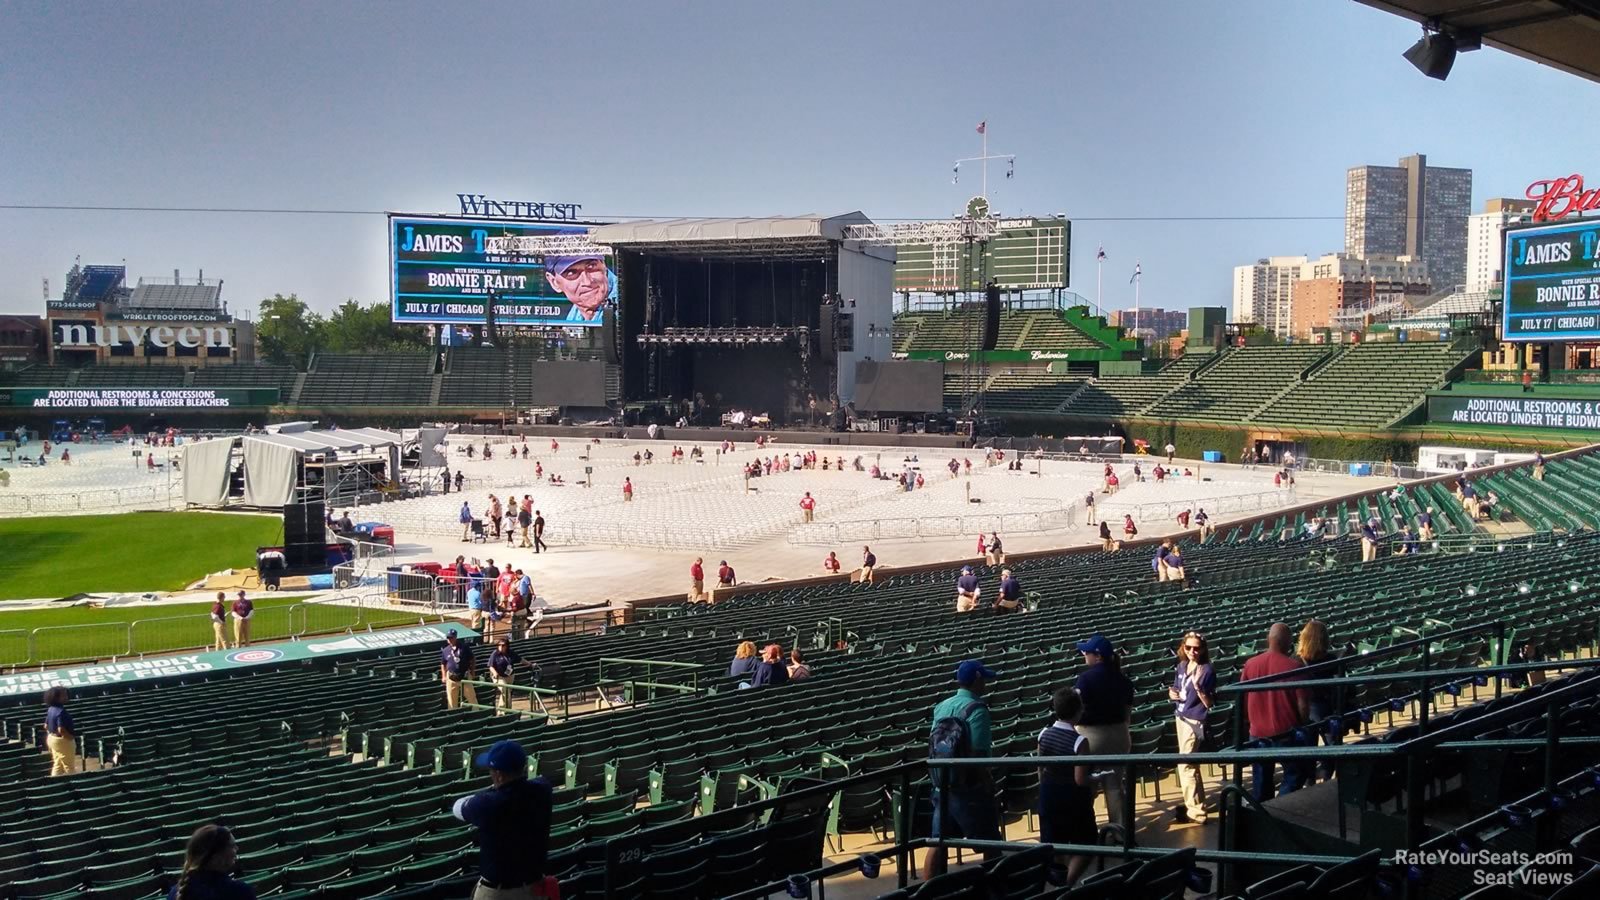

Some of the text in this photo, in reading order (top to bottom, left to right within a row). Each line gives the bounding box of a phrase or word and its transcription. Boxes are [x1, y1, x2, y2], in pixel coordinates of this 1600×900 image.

[456, 194, 582, 220] WINTRUST
[996, 220, 1033, 228] AMERICAN
[402, 226, 464, 254] JAMES
[1515, 239, 1571, 265] JAMES
[428, 272, 527, 289] BONNIE RAITT
[1536, 285, 1585, 303] BONNIE
[122, 313, 217, 321] WRIGLEYROOFTOPS.COM
[405, 303, 429, 313] JULY
[430, 303, 440, 314] 17
[446, 304, 484, 314] CHICAGO
[534, 305, 561, 316] FIELD
[1521, 316, 1595, 330] JULY 17 CHICAGO
[59, 324, 232, 348] nuveen
[1031, 351, 1069, 360] Budweiser
[48, 390, 216, 399] ADDITIONAL RESTROOMS & CONCESSIONS
[33, 398, 229, 407] ARE LOCATED UNDER THE BUDWEISER BLEACHERS
[1467, 400, 1521, 412] ADDITIONAL
[1524, 401, 1581, 414] RESTROOMS
[1584, 402, 1593, 415] &
[1452, 410, 1469, 422] ARE
[1471, 411, 1509, 424] LOCATED
[1511, 412, 1543, 425] UNDER
[1545, 413, 1564, 426] THE
[6, 655, 200, 685] THE FRIENDLY
[134, 662, 213, 679] FIELD
[618, 848, 641, 863] 229
